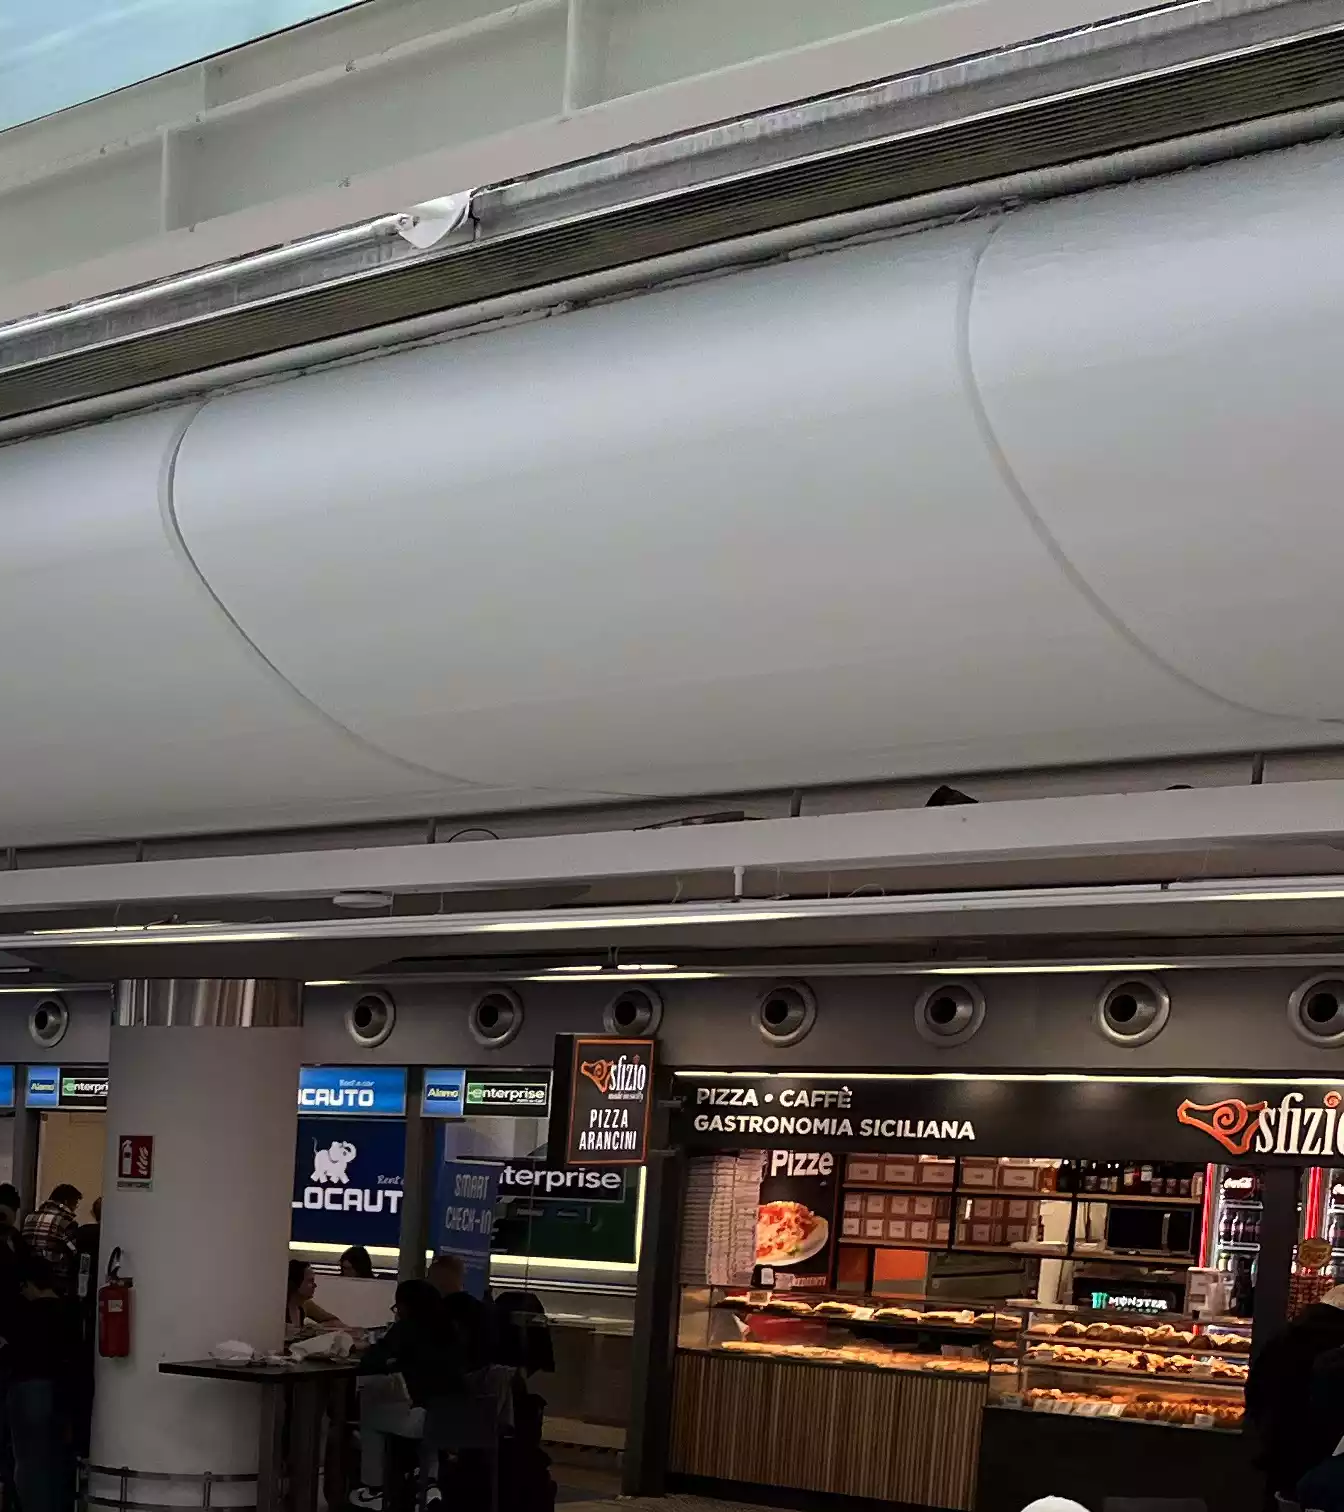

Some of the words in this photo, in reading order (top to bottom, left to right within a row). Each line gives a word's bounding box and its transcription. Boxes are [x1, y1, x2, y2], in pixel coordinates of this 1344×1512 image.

[609, 1054, 646, 1091] sfizio
[427, 1088, 459, 1098] Alamo
[470, 1087, 545, 1102] enterprise
[696, 1088, 758, 1106] PIZZA
[779, 1086, 852, 1108] CAFFÈ
[590, 1109, 628, 1128] PIZZA
[694, 1115, 853, 1136] GASTRONOMIA
[859, 1119, 975, 1140] SICILIANA
[579, 1131, 637, 1150] ARANCINI
[771, 1150, 833, 1177] Pizze
[455, 1174, 490, 1199] SMART
[445, 1207, 492, 1234] CHECK-IN
[1108, 1296, 1167, 1309] MONSTER
